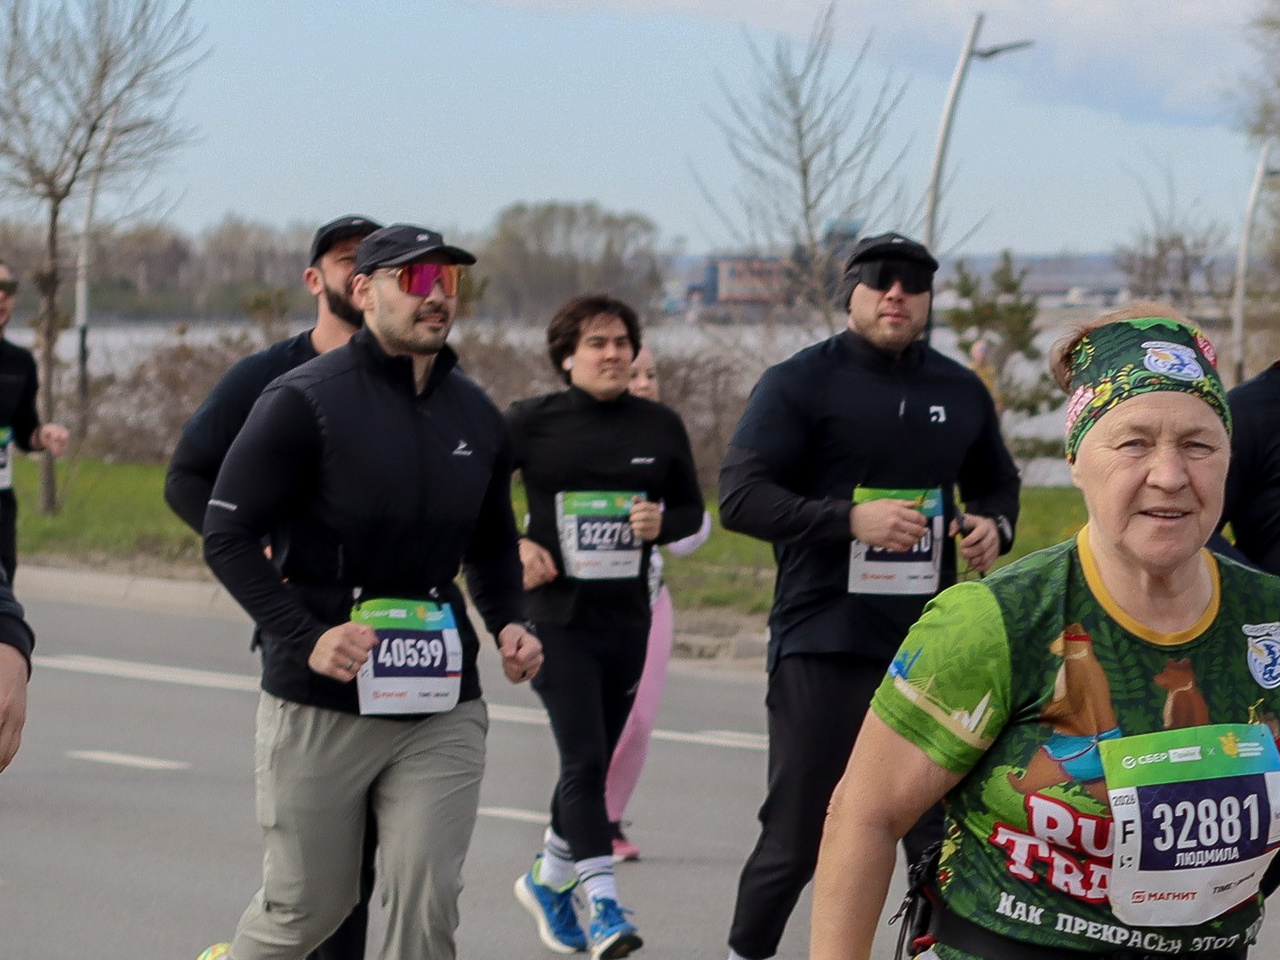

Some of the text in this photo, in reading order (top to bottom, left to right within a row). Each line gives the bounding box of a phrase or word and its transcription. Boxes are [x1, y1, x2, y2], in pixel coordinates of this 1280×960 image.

[377, 637, 444, 668] 40539
[1121, 819, 1135, 845] F
[1152, 793, 1259, 852] 32881
[1174, 846, 1240, 868] ЛЮДМИЛА
[1148, 891, 1198, 902] МАГНИТ
[996, 892, 1240, 955] КАК ПРЕКРАСЕН ЭТОТ
